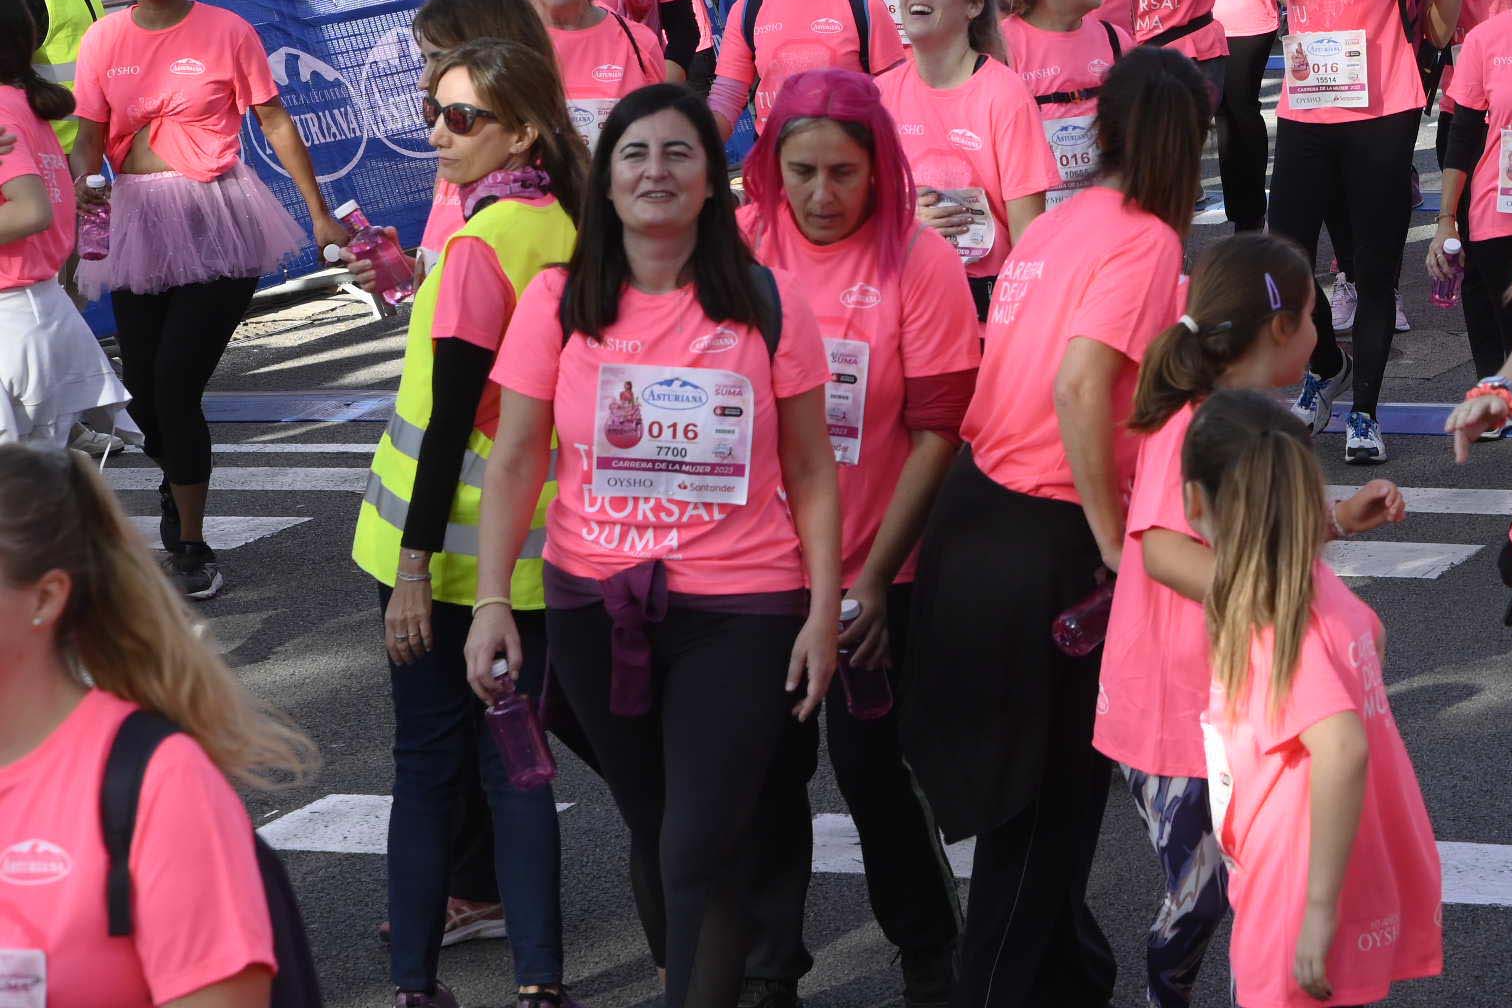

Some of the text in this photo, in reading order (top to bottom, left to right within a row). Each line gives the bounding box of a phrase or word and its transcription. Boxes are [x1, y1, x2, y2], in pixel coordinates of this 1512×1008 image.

[1312, 62, 1339, 74] 016
[1060, 152, 1091, 167] 016
[648, 391, 704, 404] ASTURIANA
[648, 421, 699, 441] 016
[655, 445, 688, 458] 7700
[611, 459, 654, 471] CARRERA
[654, 462, 667, 471] DE
[668, 463, 680, 472] LA
[681, 464, 711, 473] MUJER
[607, 477, 735, 492] OYSHO Santander
[582, 484, 728, 523] DORSAL
[582, 521, 679, 553] SUMA
